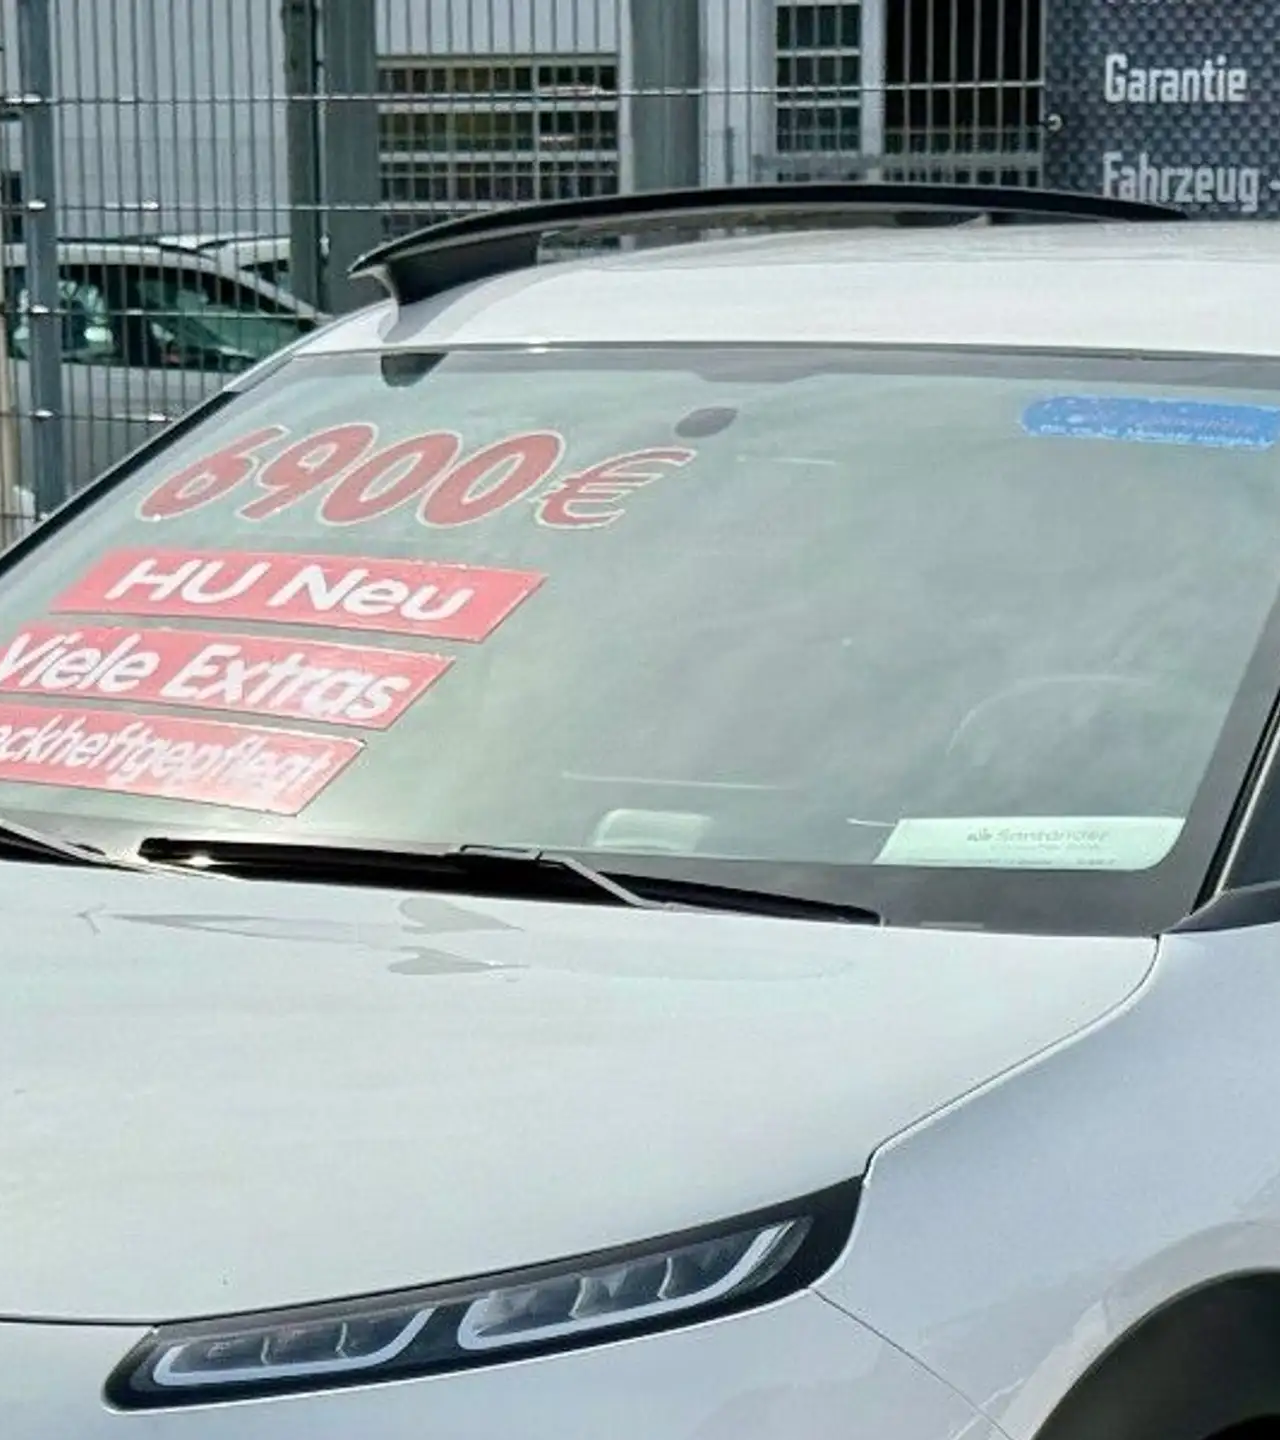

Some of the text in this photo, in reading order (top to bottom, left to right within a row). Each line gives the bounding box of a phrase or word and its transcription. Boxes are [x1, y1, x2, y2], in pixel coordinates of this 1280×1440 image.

[1104, 54, 1248, 103] Garantie
[1102, 151, 1259, 212] Fahrzeug
[106, 557, 477, 621] HU Neu
[160, 643, 412, 719] Extras
